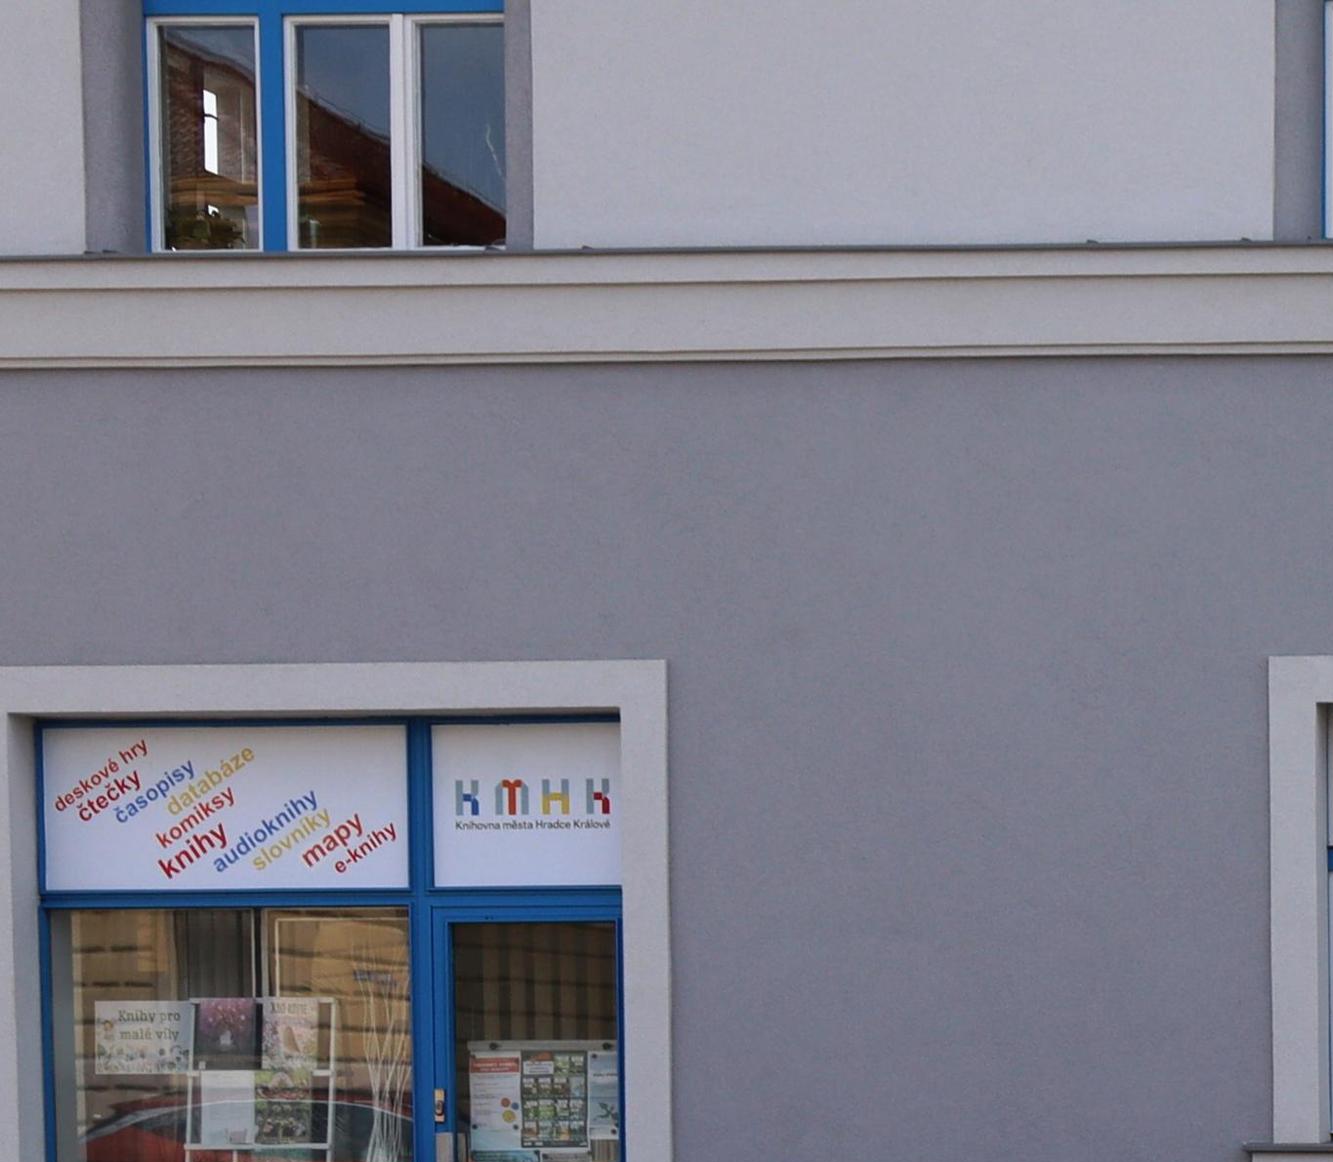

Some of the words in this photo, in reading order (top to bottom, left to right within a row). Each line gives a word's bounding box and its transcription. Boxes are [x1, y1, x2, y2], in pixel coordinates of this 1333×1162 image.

[54, 758, 120, 812] deskové
[119, 739, 149, 764] hry
[76, 770, 141, 822] čtečky
[113, 760, 195, 823] časopisy
[167, 747, 255, 816] databáze
[155, 787, 235, 849] komiksy
[213, 790, 319, 873] audioknihy
[252, 808, 332, 871] slovníky
[301, 813, 363, 868] mapy
[455, 820, 501, 831] Knihovna
[502, 820, 534, 830] města
[535, 819, 571, 829] Hradce
[573, 818, 611, 829] Králové
[158, 823, 228, 880] knihy
[334, 822, 397, 873] e-knihy
[117, 1009, 156, 1024] Knihy
[159, 1010, 181, 1023] pro
[119, 1028, 152, 1040] malé
[155, 1028, 180, 1041] víly
